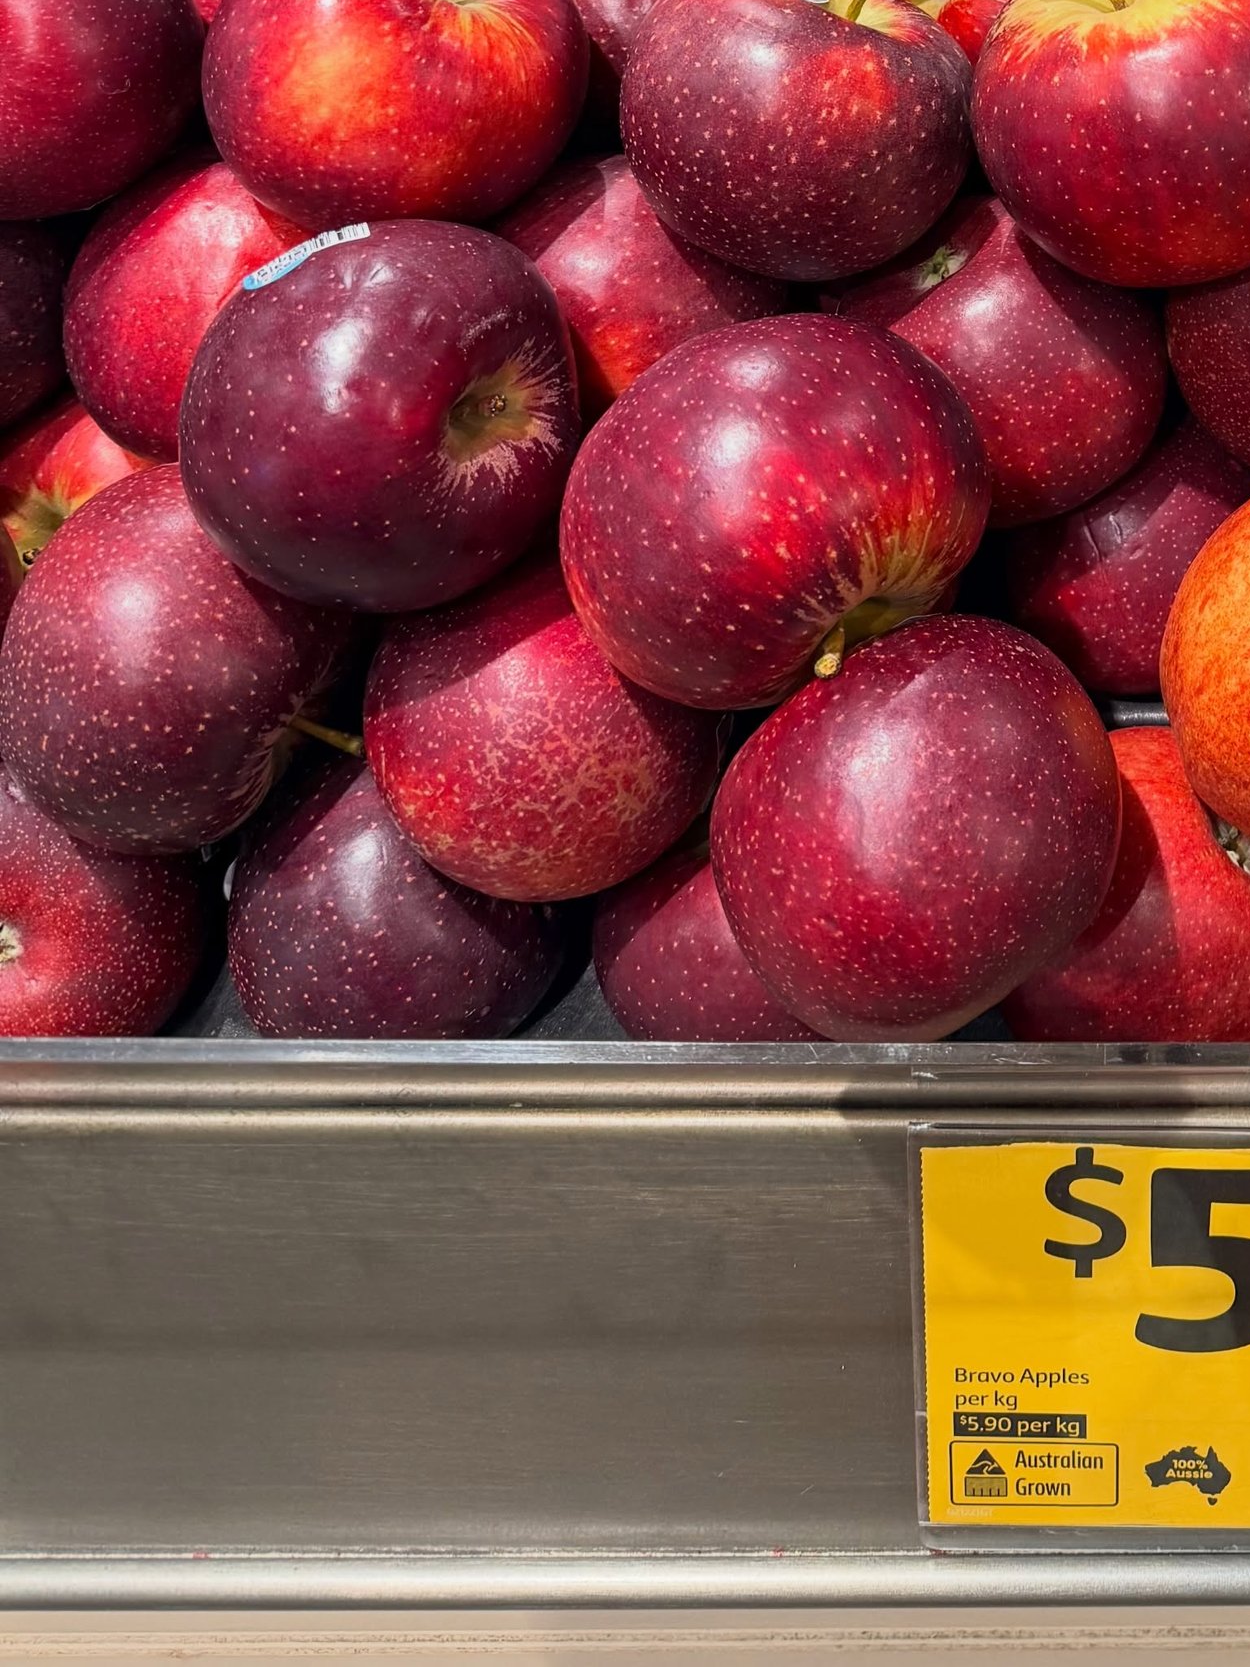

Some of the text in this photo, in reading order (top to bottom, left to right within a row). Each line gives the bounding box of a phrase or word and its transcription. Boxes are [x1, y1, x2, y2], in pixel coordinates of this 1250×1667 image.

[955, 1367, 1090, 1388] Bravo Apples
[955, 1390, 1018, 1411] per kg
[959, 1415, 1081, 1437] $5.90 per kg
[1014, 1450, 1104, 1470] Australian
[1172, 1459, 1209, 1470] 100%
[1165, 1468, 1213, 1479] Aussie
[1015, 1478, 1071, 1497] Grown
